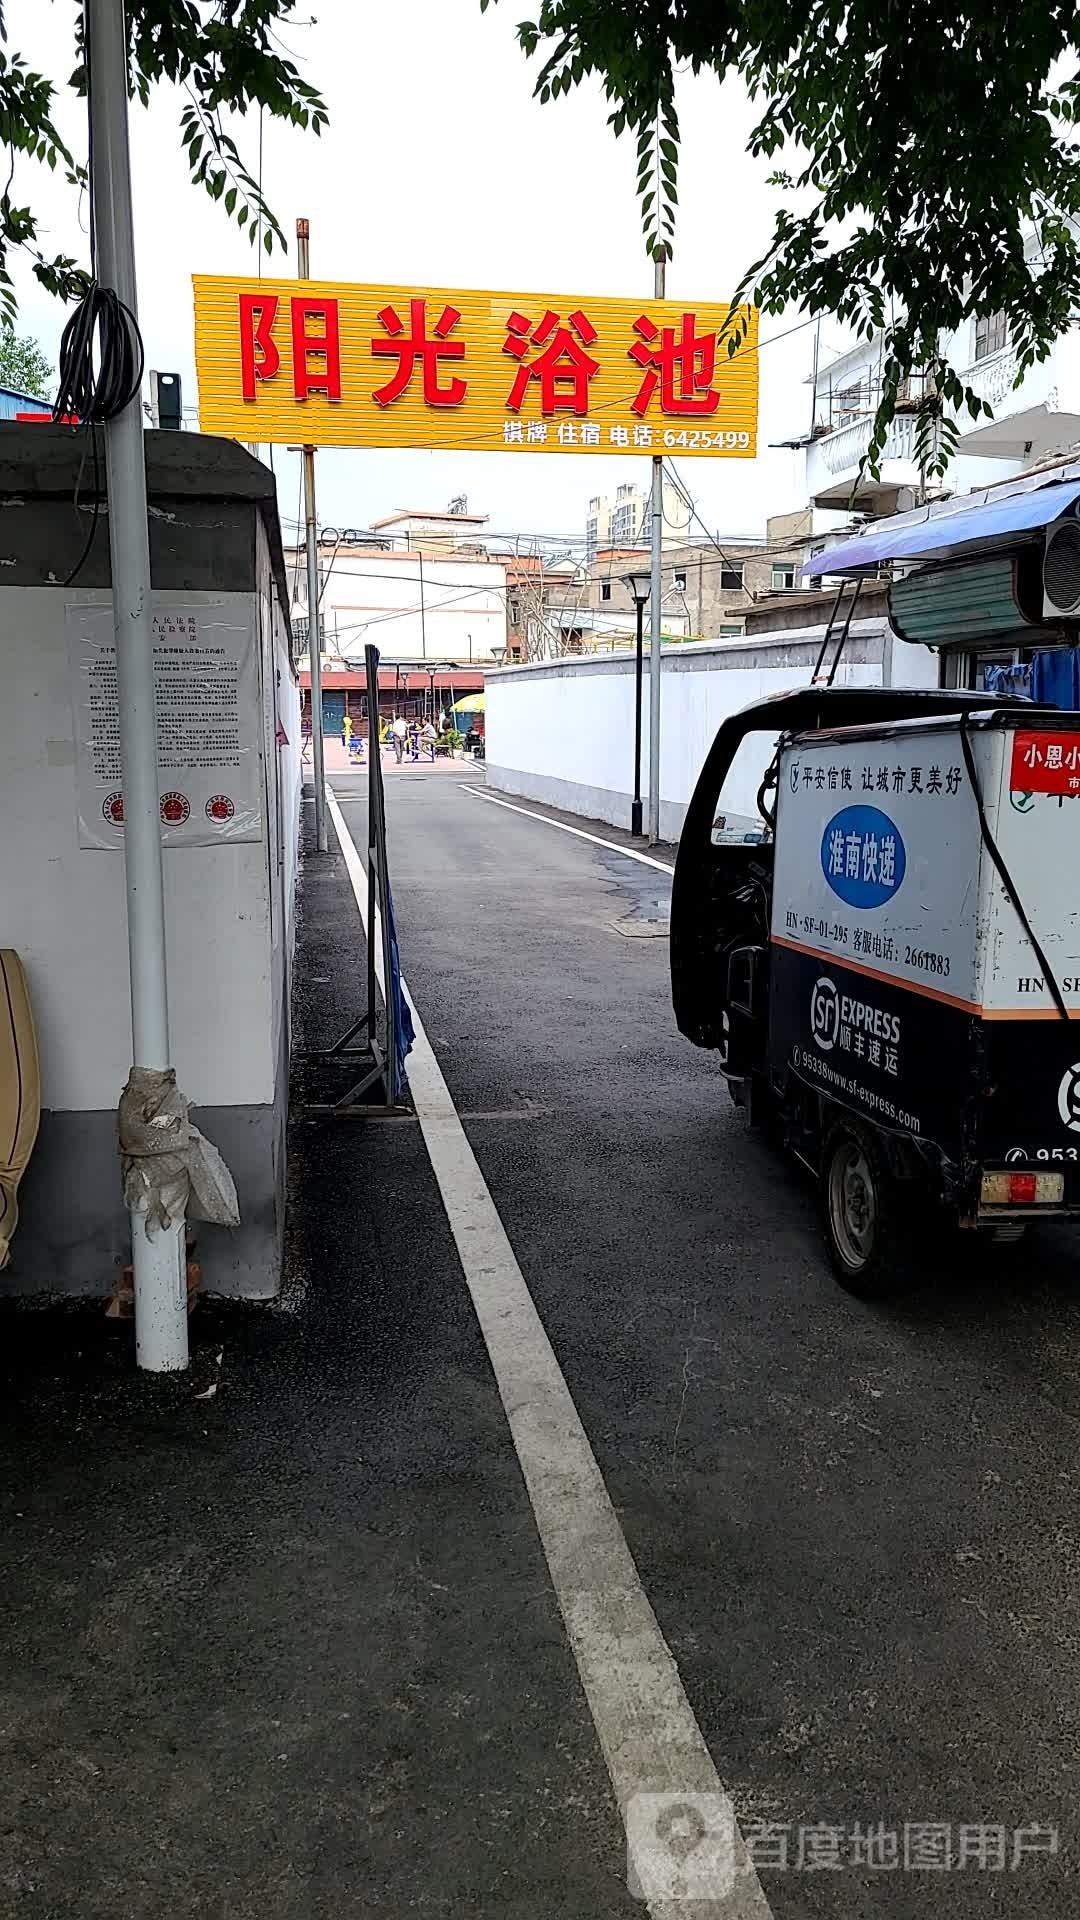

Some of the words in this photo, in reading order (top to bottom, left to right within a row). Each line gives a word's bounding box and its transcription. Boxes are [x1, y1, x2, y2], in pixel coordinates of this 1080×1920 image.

[238, 294, 720, 416] 阳光浴池
[502, 421, 548, 444] 棋牌
[558, 423, 600, 446] 住宿
[802, 766, 852, 790] 平安信使
[861, 765, 962, 795] 让城市更美好
[828, 829, 897, 887] 淮南快递
[841, 995, 900, 1044] EXPRESS
[840, 1023, 898, 1076] 顺丰速运
